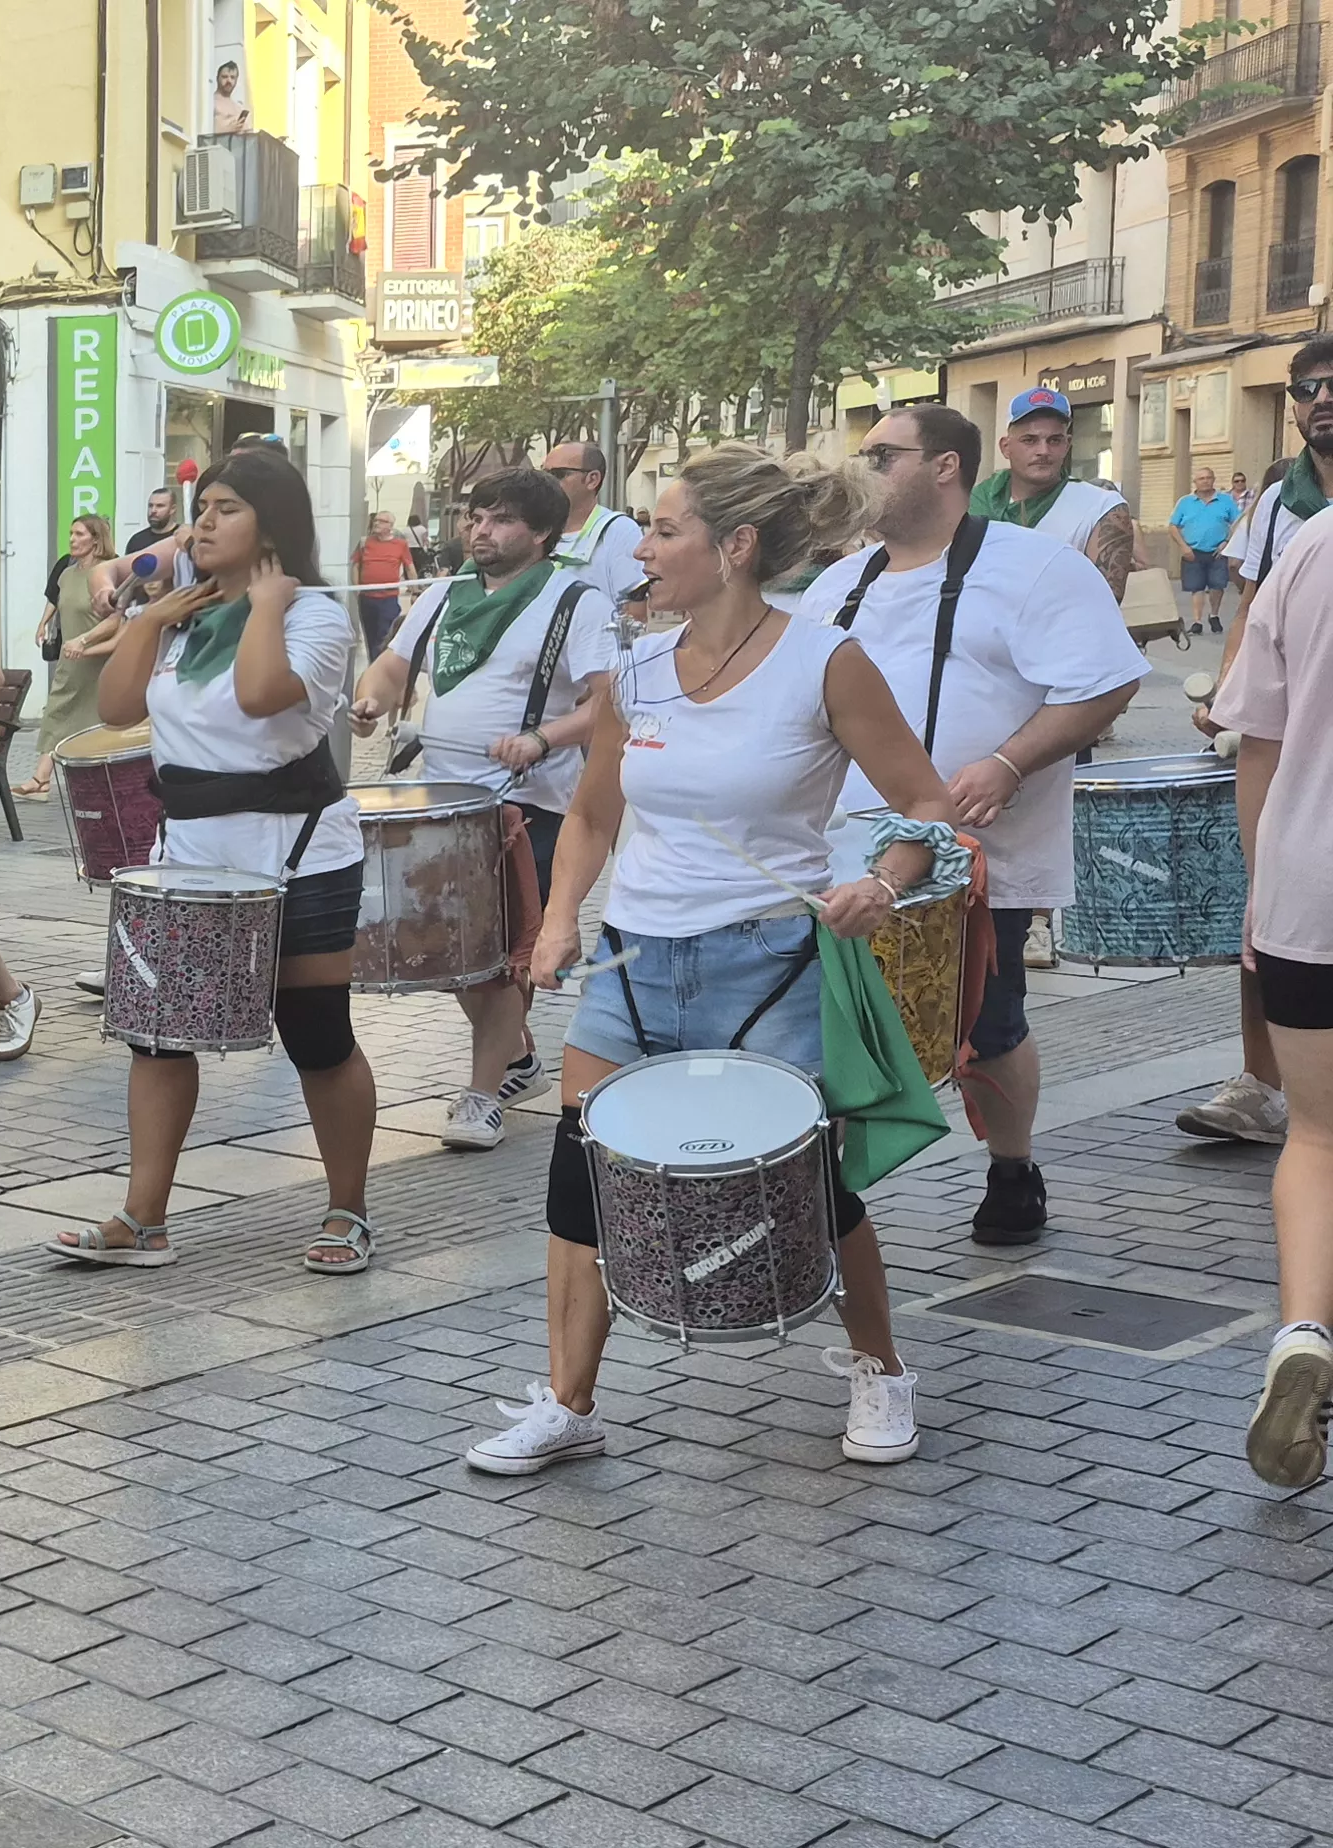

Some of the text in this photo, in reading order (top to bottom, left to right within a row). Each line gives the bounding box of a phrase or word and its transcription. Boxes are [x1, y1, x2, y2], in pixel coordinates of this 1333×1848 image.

[383, 279, 460, 295] EDITORIAL
[171, 301, 217, 318] PLAZA
[383, 299, 460, 331] PIRINEO
